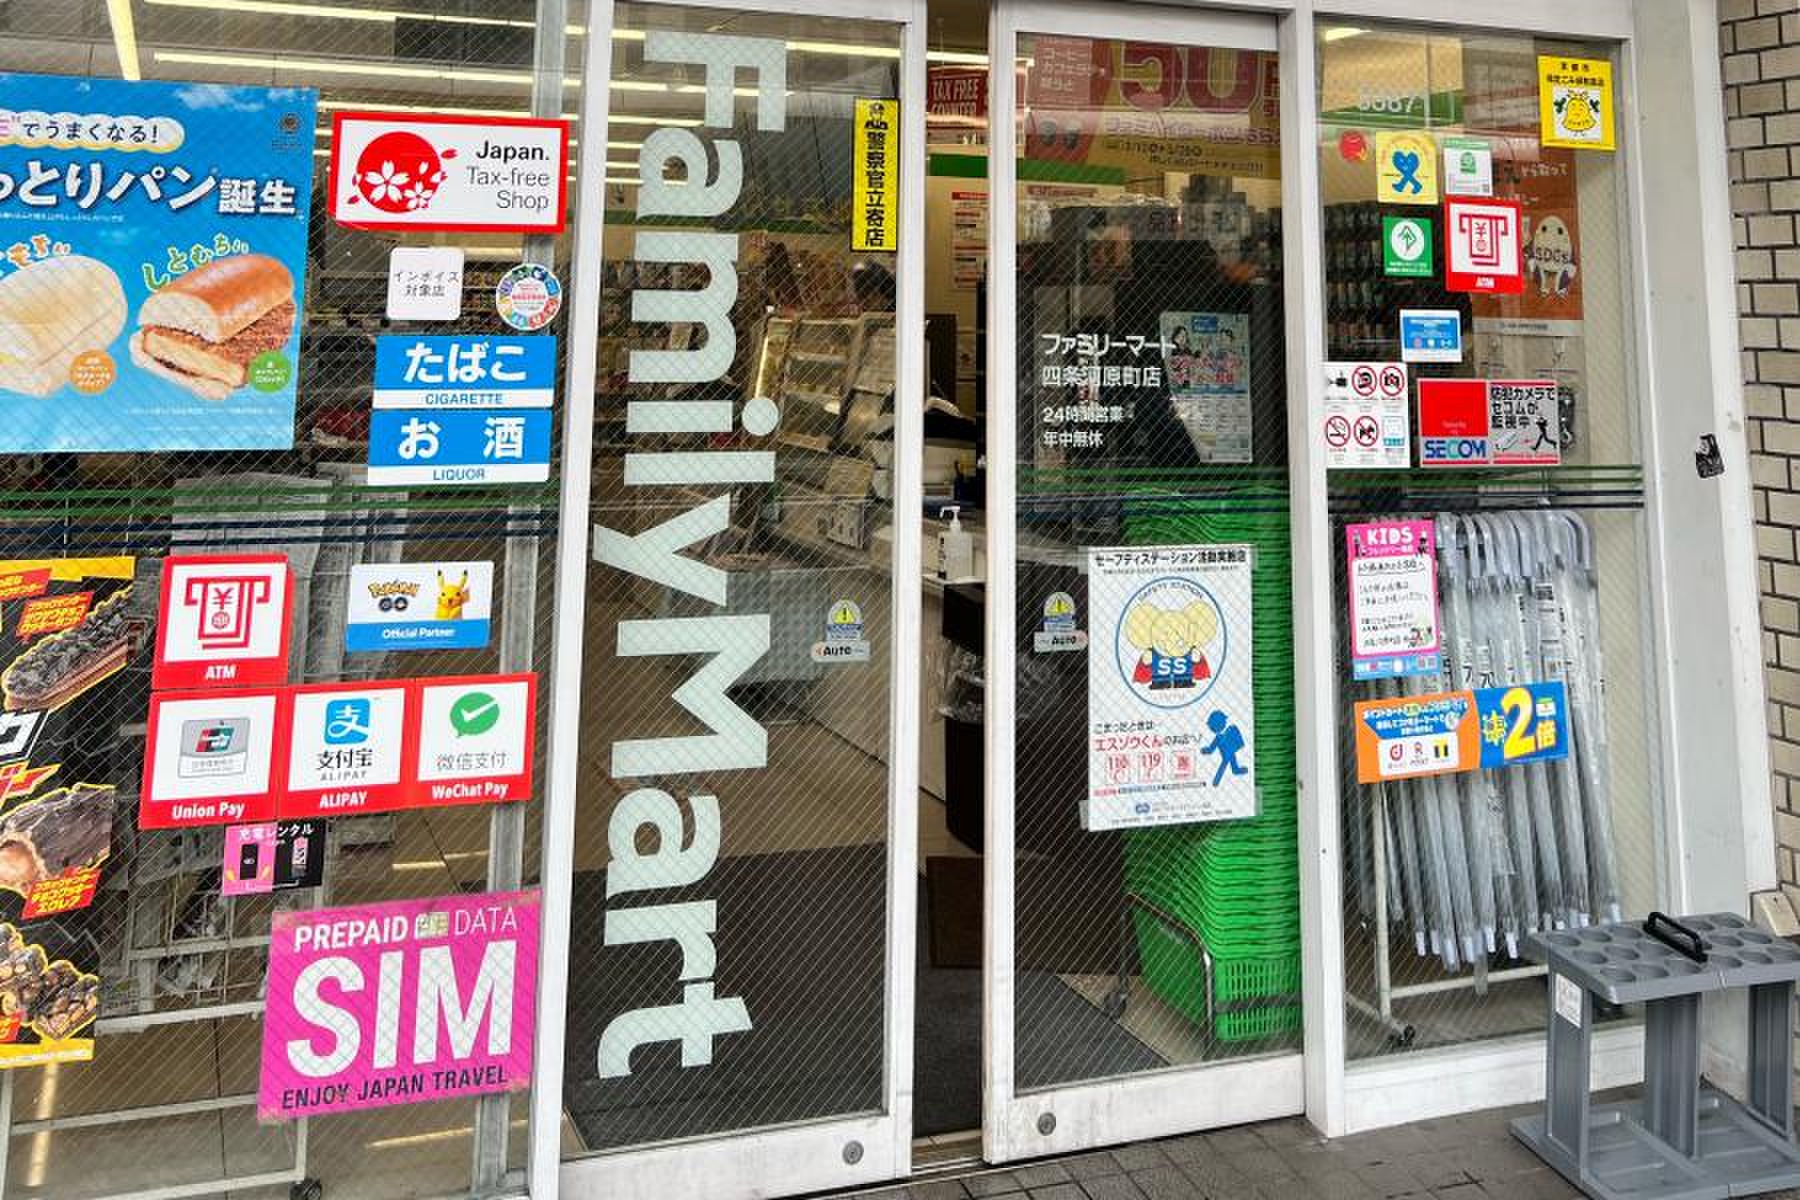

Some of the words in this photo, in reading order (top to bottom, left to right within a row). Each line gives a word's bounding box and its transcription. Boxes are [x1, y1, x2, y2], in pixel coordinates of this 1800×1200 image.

[475, 141, 550, 165] Japan.
[467, 166, 550, 188] Tax-free
[219, 178, 295, 215] 誕生
[865, 131, 886, 247] 警察官立寄店
[496, 190, 550, 214] Shop
[393, 271, 459, 285] インボイス
[404, 284, 446, 298] 対象店
[1041, 334, 1177, 359] ファミリーマート
[404, 342, 527, 383] たばこ
[1042, 366, 1162, 387] 四条河原町店
[425, 393, 503, 406] CIGARETTE
[1491, 401, 1539, 415] セコムが
[1043, 431, 1104, 449] 年中無休
[1425, 440, 1486, 459] SECOM
[432, 468, 486, 482] LIQUOR
[1367, 527, 1413, 545] KIDS
[593, 30, 787, 1080] FamilyMart
[382, 628, 417, 639] Official
[419, 628, 456, 638] Partner
[205, 665, 237, 680] ATM
[1157, 657, 1187, 674] SS
[1502, 688, 1537, 759] 2
[316, 747, 373, 772] 支付宝
[436, 750, 509, 772] 微信支付
[319, 769, 368, 783] ALIPAY
[319, 791, 368, 809] ALIPAY
[431, 783, 483, 800] WeChat
[485, 782, 509, 800] Pay
[172, 803, 215, 819] Union
[219, 800, 245, 820] Pay
[294, 915, 408, 953] PREPAID
[454, 907, 518, 936] DATA
[287, 939, 517, 1078] SIM
[282, 1083, 349, 1110] ENJOY
[357, 1074, 424, 1101] JAPAN
[432, 1064, 508, 1091] TRAVEL
